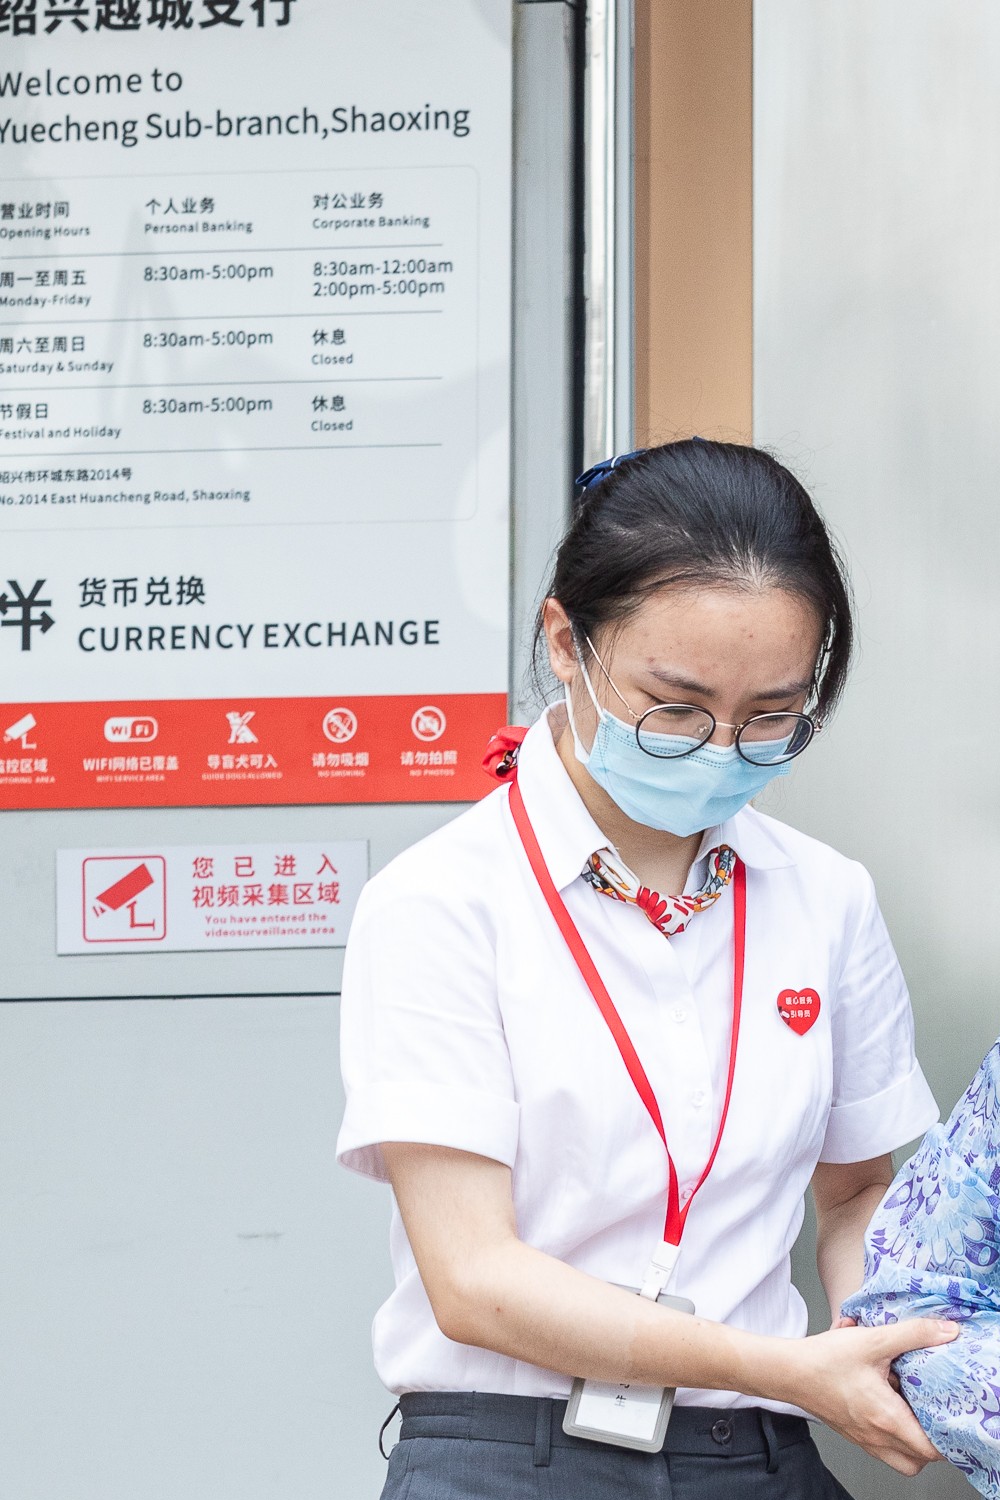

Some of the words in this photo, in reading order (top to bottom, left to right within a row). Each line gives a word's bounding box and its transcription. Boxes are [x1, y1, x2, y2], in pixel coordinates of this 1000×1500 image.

[0, 69, 142, 98] Welcome
[152, 68, 184, 92] to
[0, 114, 139, 148] Yuecheng
[145, 197, 215, 216] 个人业务
[313, 191, 384, 211] 对公业务
[0, 201, 70, 220] 营业时间
[144, 221, 198, 234] Personal
[202, 219, 253, 235] Banking
[312, 216, 376, 231] Corporate
[379, 214, 430, 229] Banking
[0, 226, 51, 240] Opening
[54, 226, 91, 238] Hours
[143, 264, 274, 283] 8:30am-5:00pm
[313, 258, 454, 277] 8:30am-12:00am
[0, 269, 87, 288] 周一至周五
[313, 278, 445, 298] 2:00pm-5:00pm
[0, 294, 92, 308] Monday-Friday
[0, 335, 86, 354] 周六至周日
[142, 330, 274, 349] 8:30am-5:00pm
[312, 328, 347, 346] 休息
[0, 361, 54, 375] Saturday
[56, 360, 65, 372] &
[67, 359, 115, 374] Sunday
[311, 353, 354, 367] Closed
[0, 402, 49, 420] 节假日
[142, 397, 274, 416] 8:30am-5:00pm
[311, 395, 346, 413] 休息
[47, 427, 71, 439] and
[73, 425, 122, 440] Holiday
[311, 419, 354, 433] Closed
[50, 492, 77, 505] East
[79, 490, 151, 505] Huancheng
[153, 489, 190, 503] Road,
[192, 487, 251, 504] Shaoxing
[78, 574, 206, 608] 货币兑换
[78, 624, 255, 652] CURRENCY
[265, 620, 440, 650] EXCHANGE
[207, 753, 278, 770] 导盲犬可入
[312, 752, 369, 767] 请勿吸烟
[400, 750, 458, 766] 请勿拍照
[192, 853, 338, 879] 您已进入
[192, 881, 340, 908] 视频采集区域
[205, 915, 227, 925] You
[229, 914, 258, 924] have
[260, 913, 306, 923] entered
[308, 912, 327, 922] the
[310, 926, 336, 935] area
